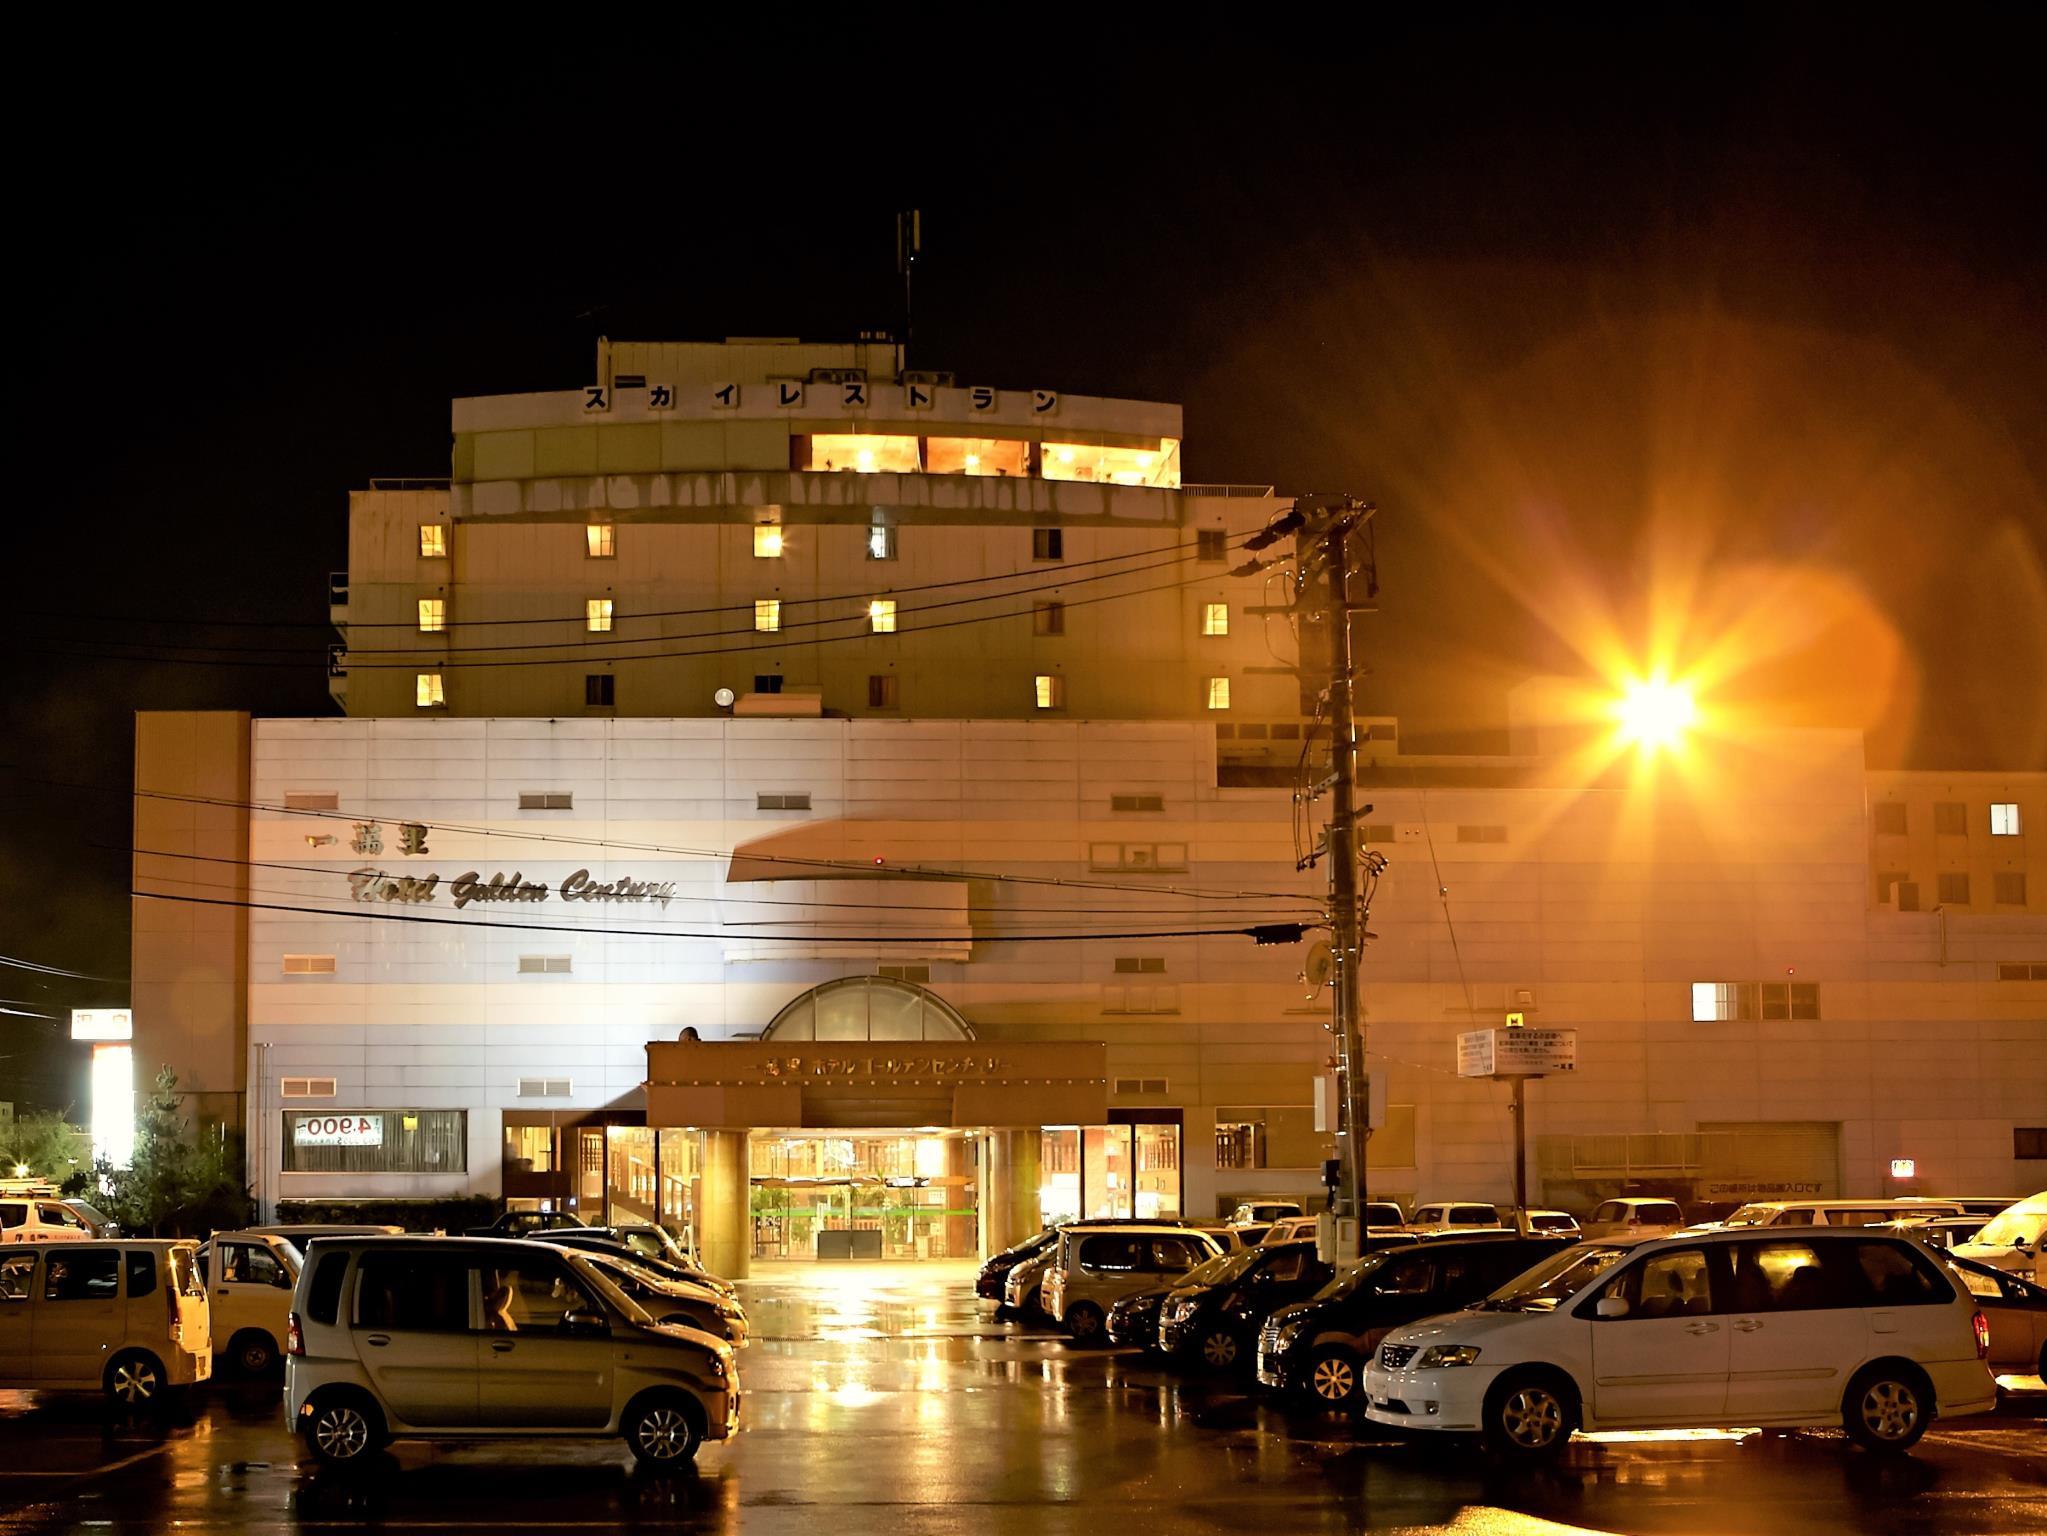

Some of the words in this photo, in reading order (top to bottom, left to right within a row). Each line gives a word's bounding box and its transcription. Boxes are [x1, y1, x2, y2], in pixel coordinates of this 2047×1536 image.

[585, 382, 1056, 412] スカイレストラン
[347, 867, 439, 903] Hotel
[450, 871, 549, 909] Golden
[559, 868, 677, 910] Century
